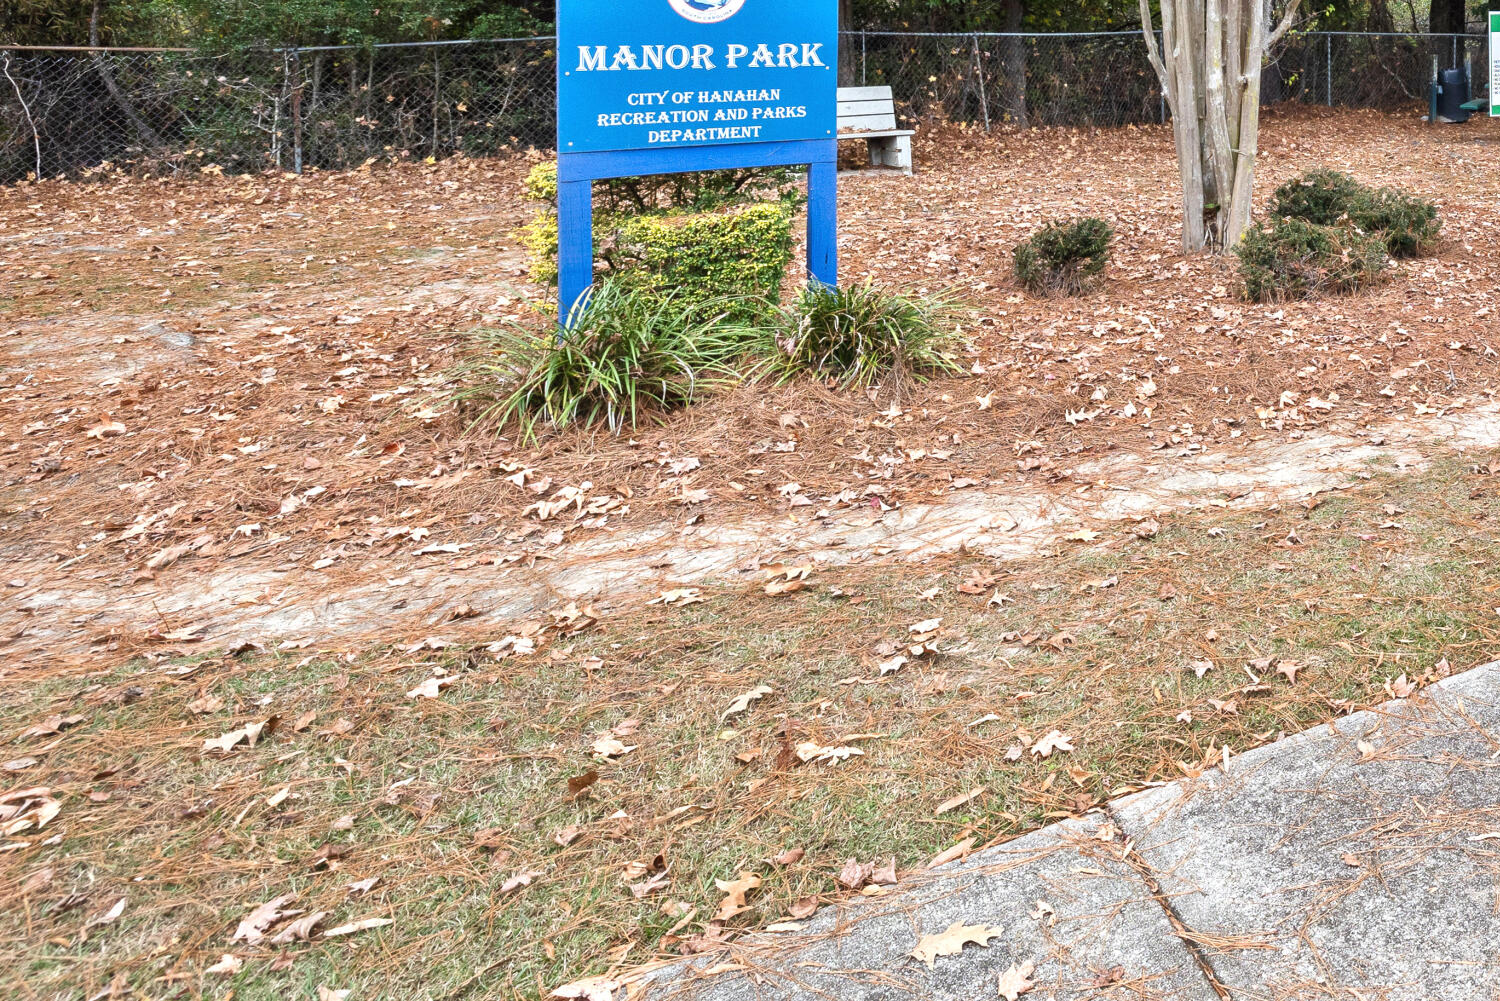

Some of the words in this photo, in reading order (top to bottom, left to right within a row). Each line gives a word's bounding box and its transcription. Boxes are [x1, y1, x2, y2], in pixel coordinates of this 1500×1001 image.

[576, 44, 717, 72] MANOR
[725, 43, 826, 69] PARK
[627, 90, 670, 106] CITY
[671, 91, 694, 104] OF
[698, 89, 781, 103] HANAHAN
[597, 110, 709, 127] RECREATION
[713, 108, 748, 121] AND
[751, 106, 807, 120] PARKS
[648, 126, 762, 143] DEPARTMENT
